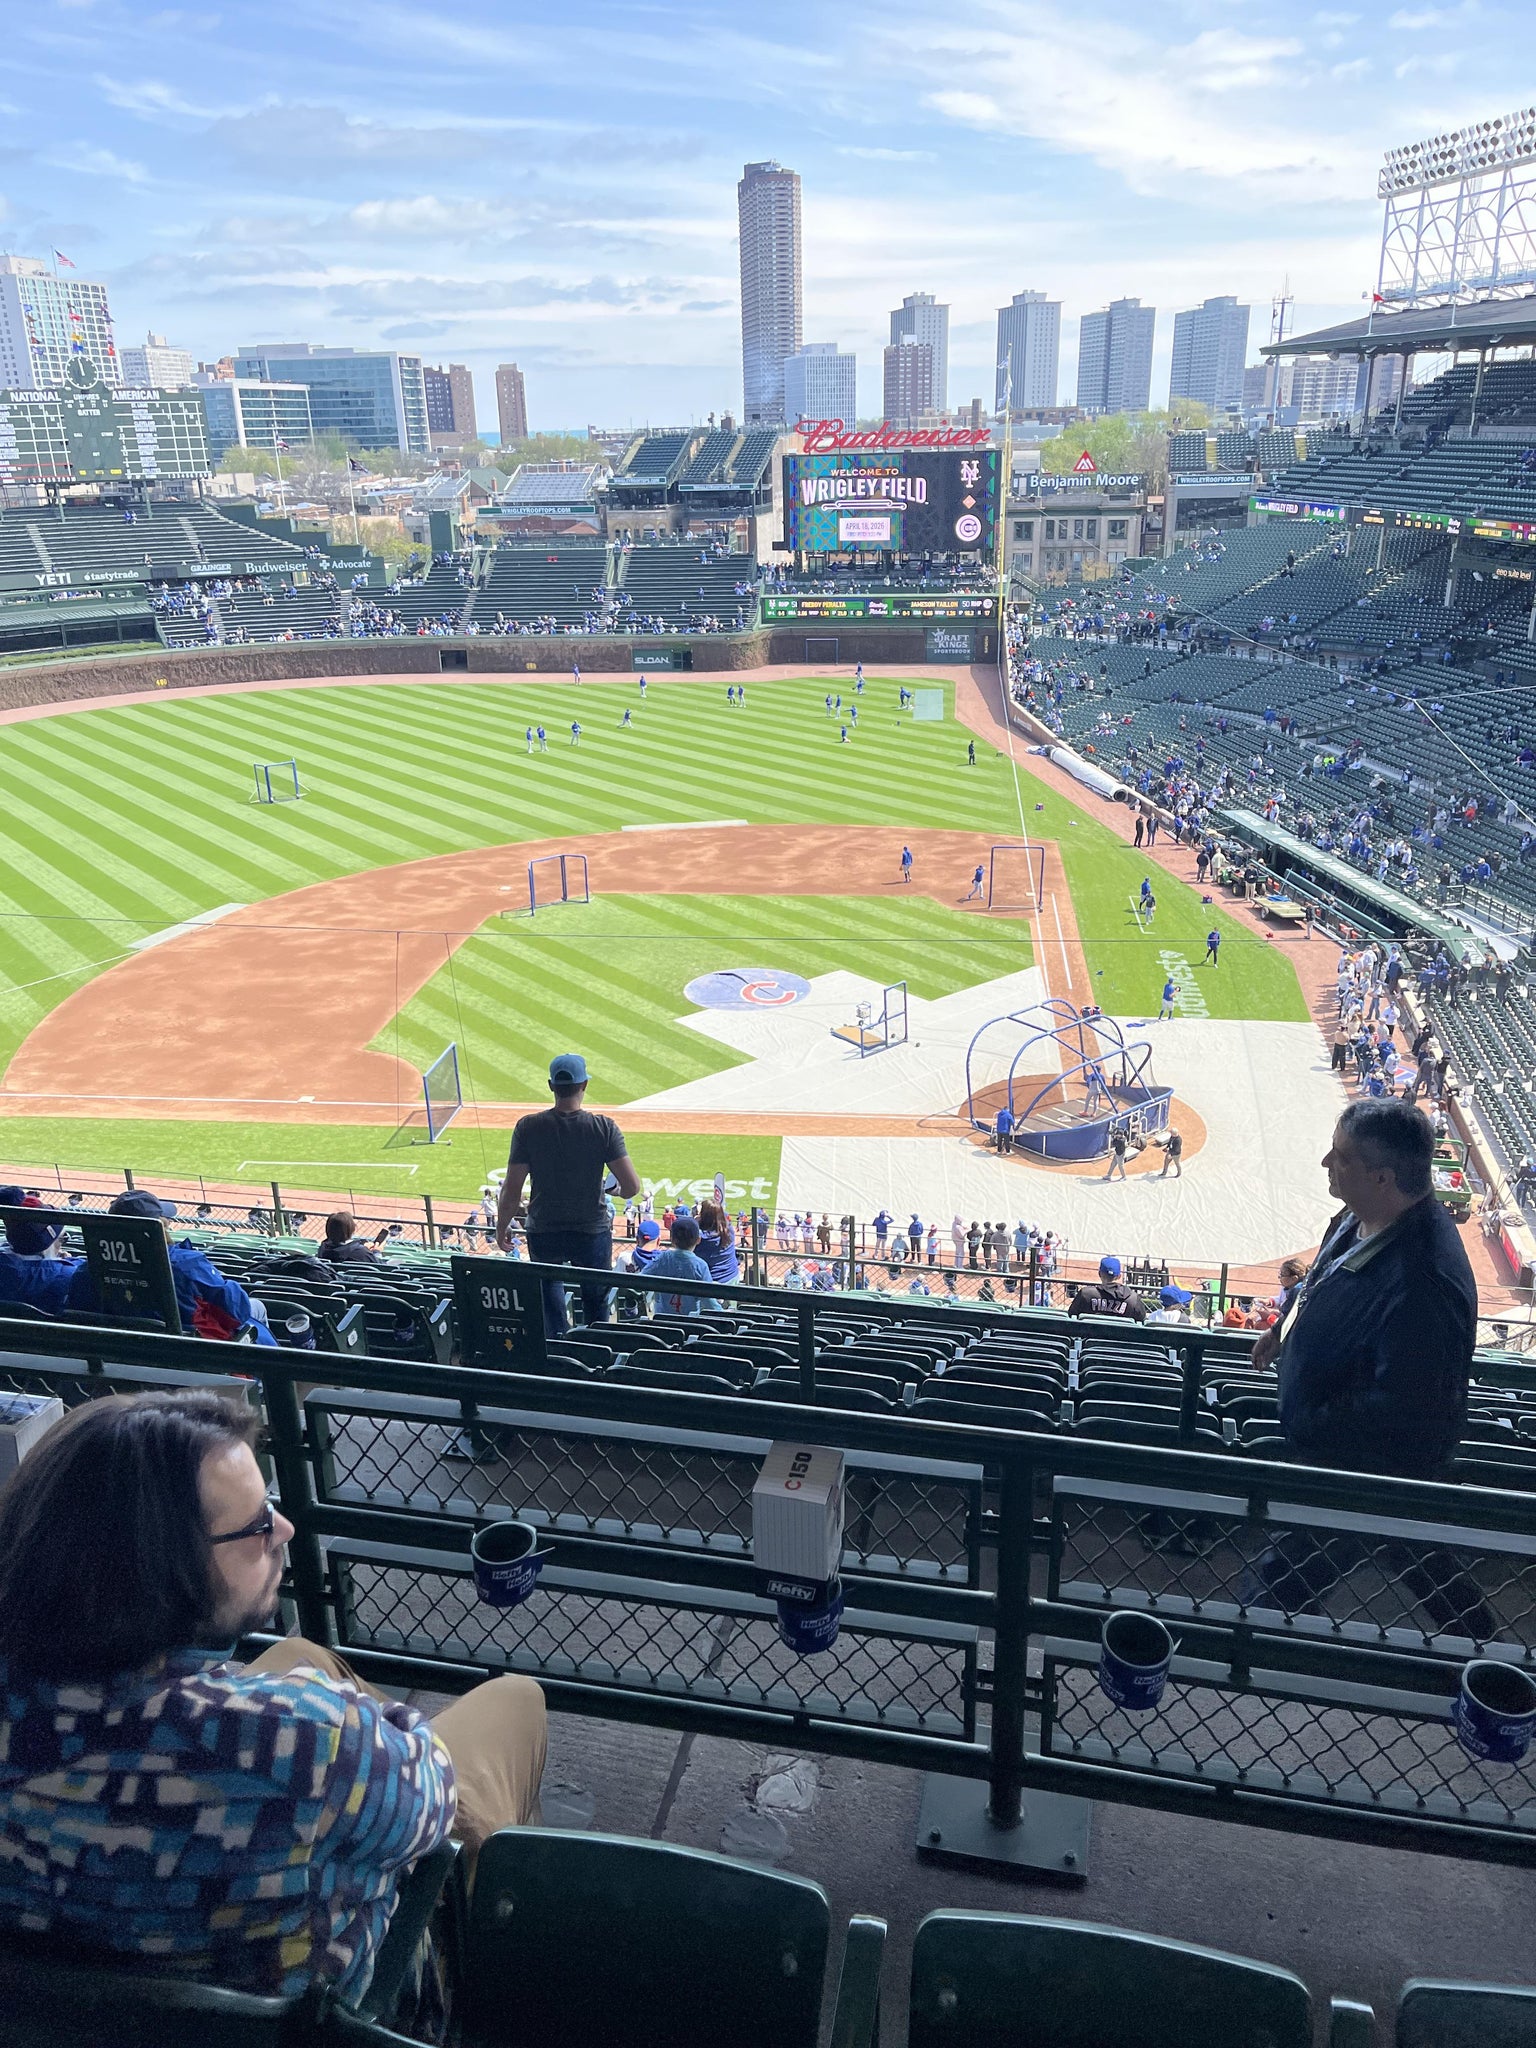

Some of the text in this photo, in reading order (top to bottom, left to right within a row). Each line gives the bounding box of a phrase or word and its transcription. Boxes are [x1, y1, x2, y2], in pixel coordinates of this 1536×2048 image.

[10, 391, 62, 402] NATIONAL
[112, 390, 160, 400] AMERICAN
[794, 418, 991, 454] Budweiser
[830, 468, 882, 476] WELCOME
[1030, 474, 1139, 490] Benjamin Moore
[801, 477, 928, 506] WRIGLEY FIELD
[190, 564, 232, 572] GRAINGER
[246, 562, 308, 574] Budweiser
[332, 560, 370, 569] Advocate
[34, 572, 72, 586] YETI
[90, 570, 140, 582] tastytrade
[1508, 569, 1519, 578] suite
[1520, 571, 1532, 580] level
[934, 634, 970, 643] DRAFT
[100, 1240, 142, 1264] 312 L
[104, 1276, 132, 1286] SEAT
[480, 1286, 525, 1312] 313 L
[1091, 1298, 1128, 1314] PIAZZA
[488, 1326, 516, 1334] SEAT
[770, 1582, 812, 1600] Hefty
